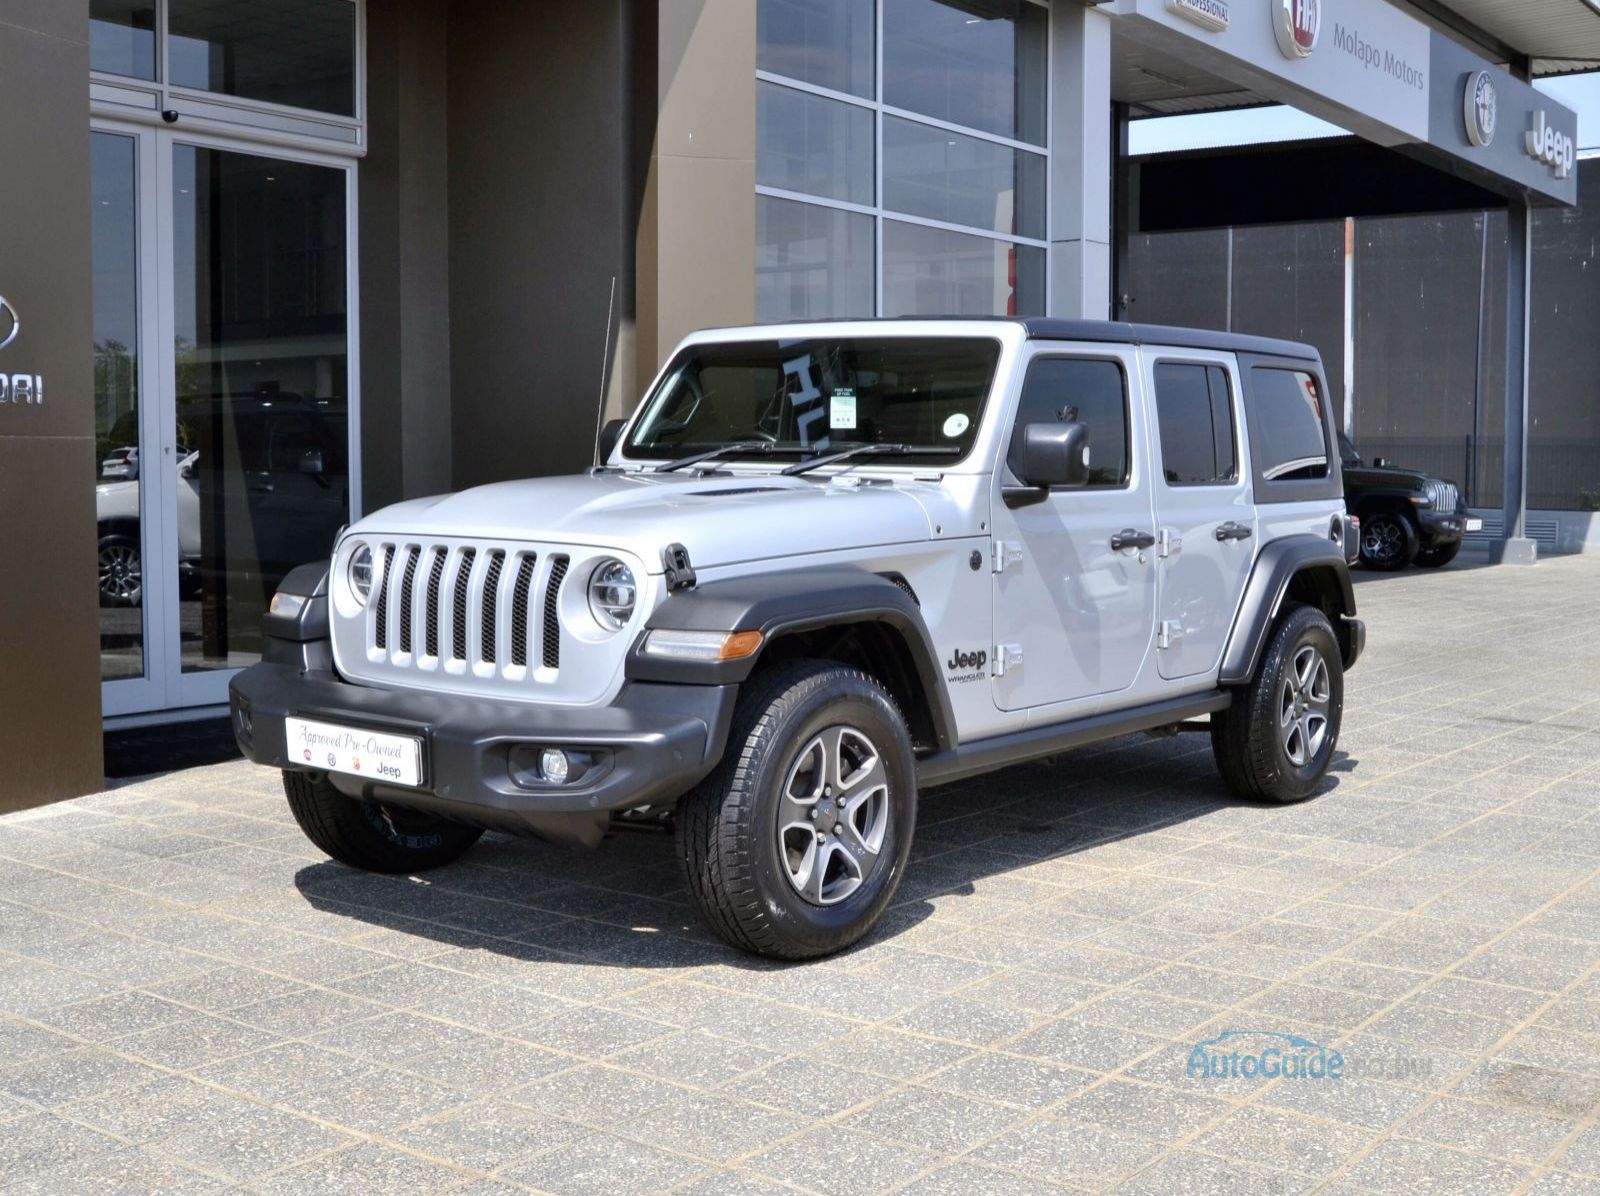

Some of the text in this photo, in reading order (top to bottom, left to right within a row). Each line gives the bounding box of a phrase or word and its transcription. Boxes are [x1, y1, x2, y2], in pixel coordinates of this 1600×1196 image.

[1186, 0, 1228, 22] OFESSIONAL
[1334, 23, 1423, 90] Molapo Motors
[1532, 110, 1573, 177] Jeep
[948, 648, 987, 670] Jeep
[299, 725, 402, 759] Approved Pre-Owned
[377, 762, 402, 779] Jeep
